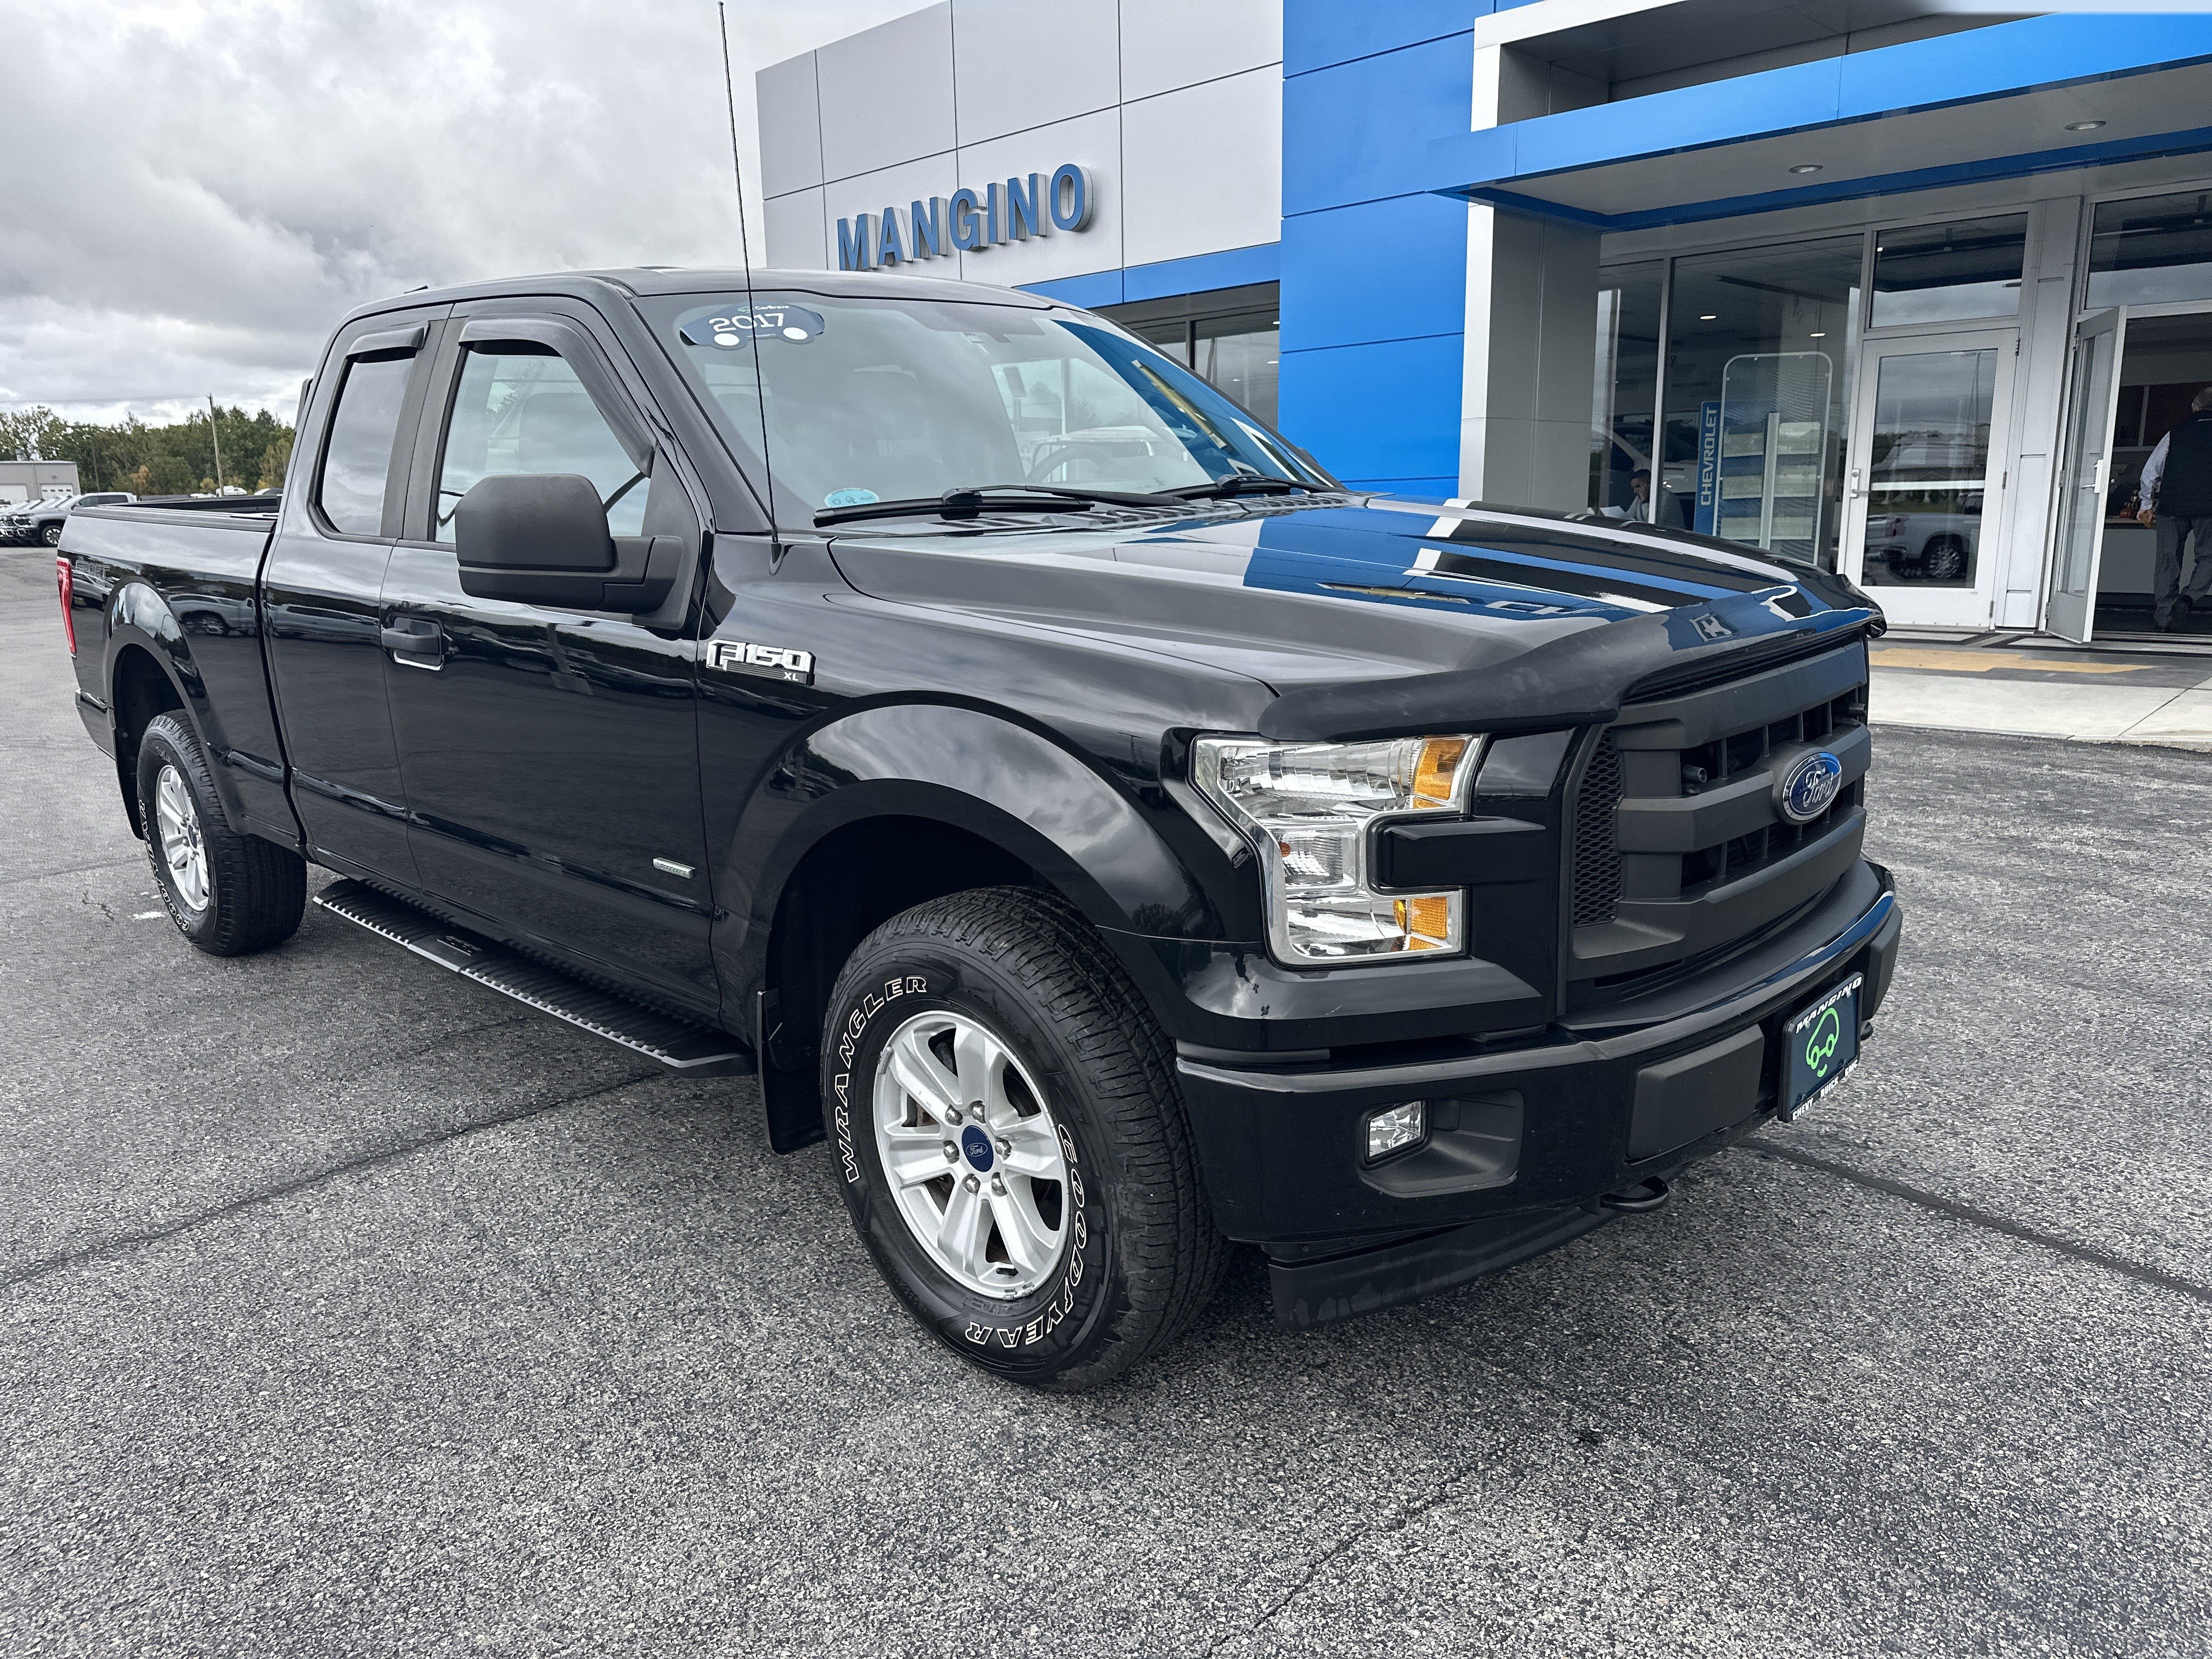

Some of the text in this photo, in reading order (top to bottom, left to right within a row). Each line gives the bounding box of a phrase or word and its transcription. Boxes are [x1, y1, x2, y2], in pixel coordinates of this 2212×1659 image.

[837, 163, 1093, 271] MANGINO
[708, 313, 784, 332] 2017
[1701, 407, 1717, 506] CHEVROLET
[783, 672, 799, 681] XL
[1801, 766, 1835, 809] Ford
[1796, 976, 1862, 1034] MANGINO
[835, 975, 927, 1183] WRANGLER
[1792, 1059, 1858, 1121] CHEVY BUICK GMC
[968, 1144, 984, 1155] Ford
[965, 1123, 1086, 1348] GOODYEAR
